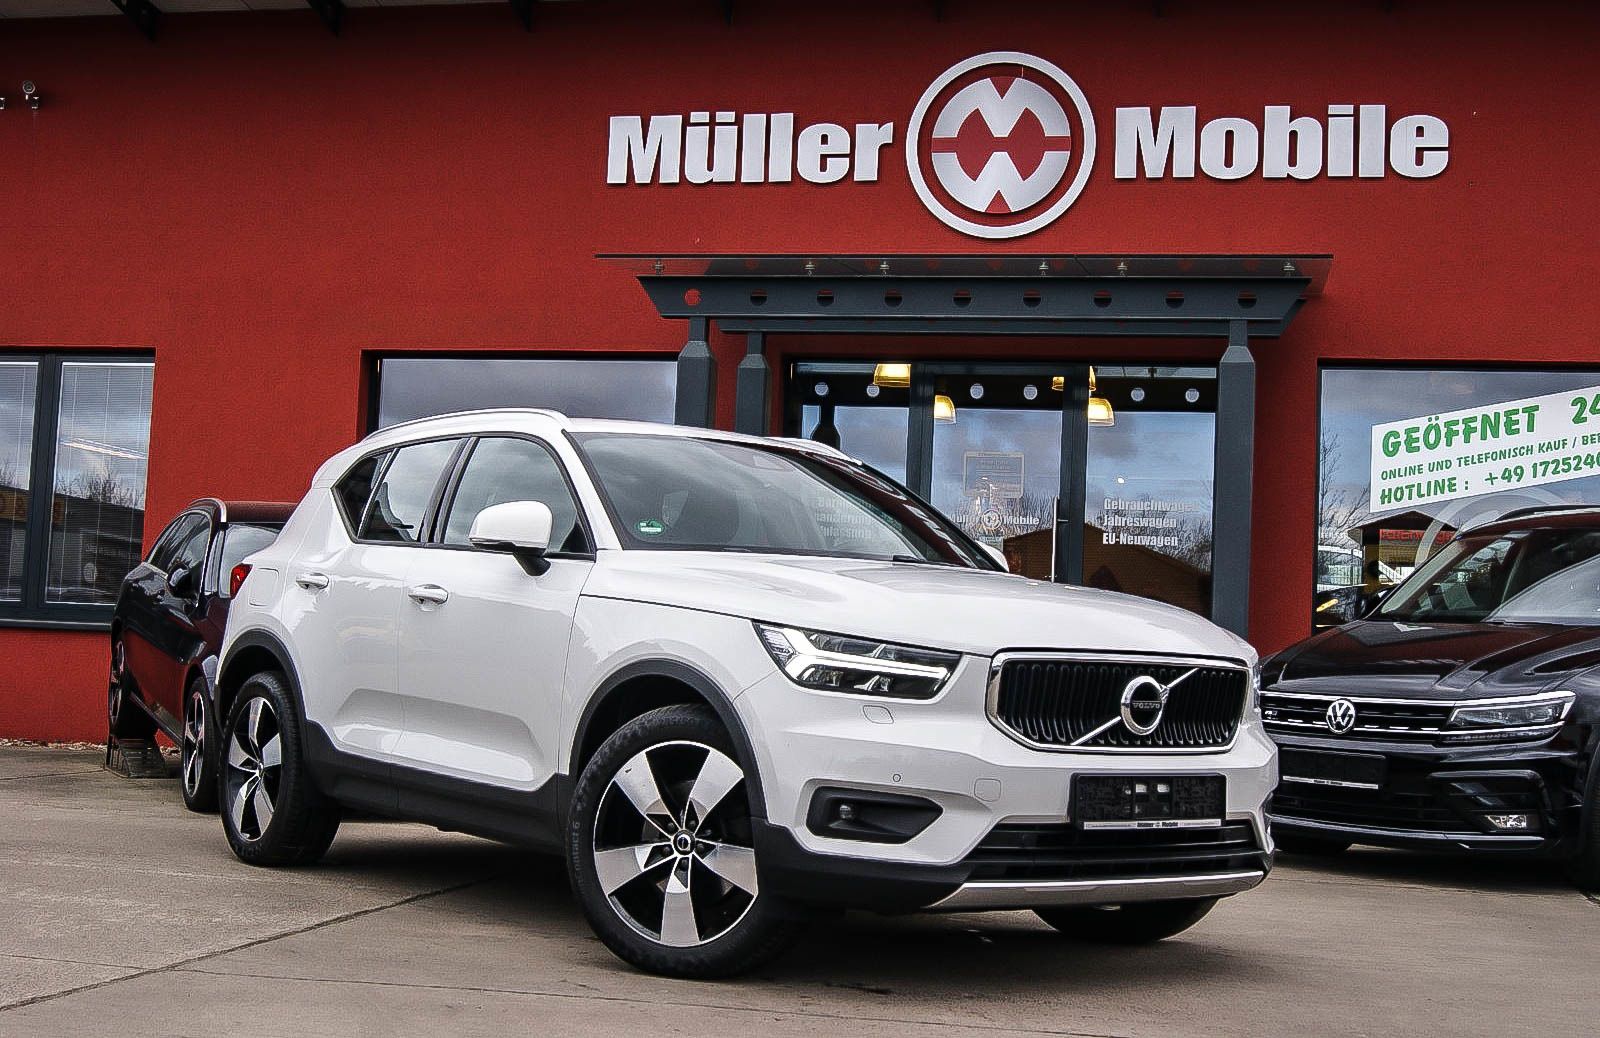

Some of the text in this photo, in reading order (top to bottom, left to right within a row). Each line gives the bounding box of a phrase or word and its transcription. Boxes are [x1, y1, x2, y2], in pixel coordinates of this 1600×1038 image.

[606, 111, 894, 185] Müller
[1115, 104, 1449, 180] Mobile
[1382, 404, 1540, 458] GEÖFFNET
[1380, 464, 1424, 481] ONLINE
[1427, 459, 1453, 473] UND
[1456, 444, 1534, 467] TELEFONISCH
[1537, 438, 1568, 454] KAUF
[1379, 476, 1457, 506] HOTLINE
[1484, 465, 1525, 486] +49
[1102, 532, 1178, 547] EU-Neuwagen
